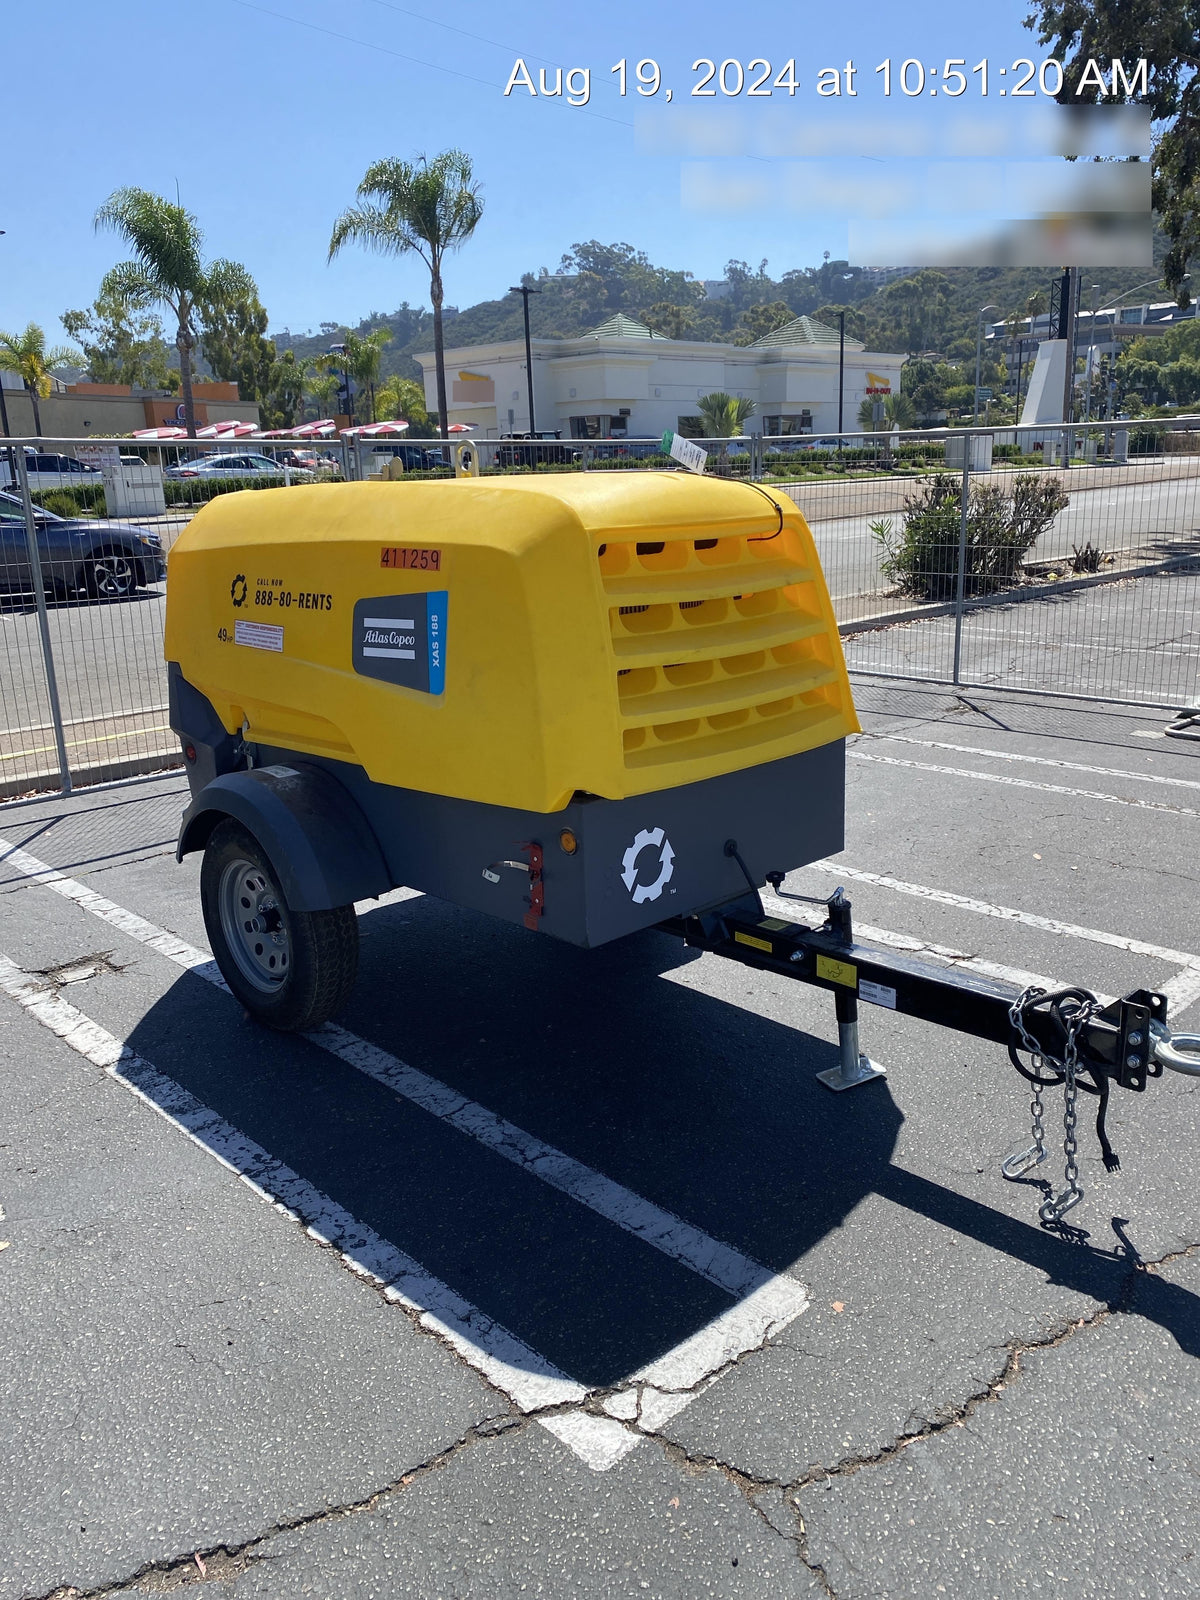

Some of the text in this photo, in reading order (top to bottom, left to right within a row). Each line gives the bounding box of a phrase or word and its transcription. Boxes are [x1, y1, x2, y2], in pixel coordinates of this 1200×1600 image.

[381, 548, 440, 569] 411259
[256, 578, 283, 587] CALL NOW
[254, 590, 333, 611] 888-80-RENTS
[431, 614, 440, 667] XAS 188
